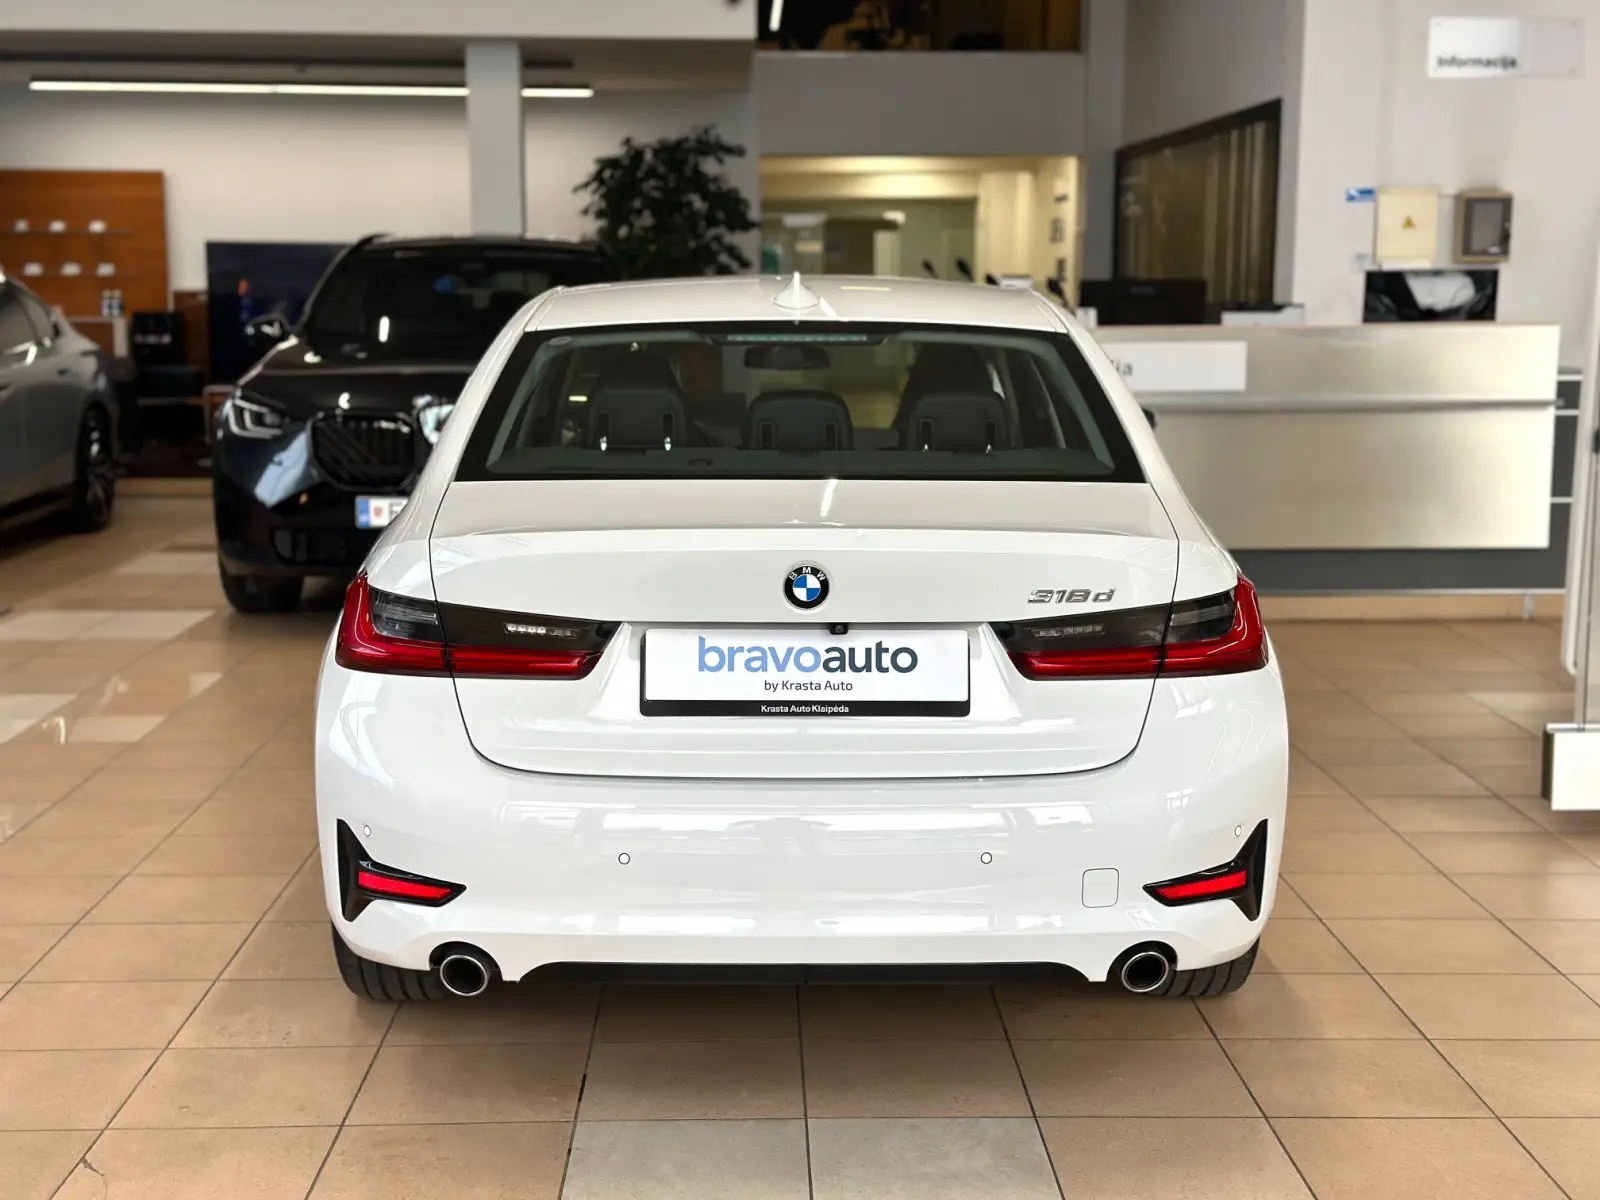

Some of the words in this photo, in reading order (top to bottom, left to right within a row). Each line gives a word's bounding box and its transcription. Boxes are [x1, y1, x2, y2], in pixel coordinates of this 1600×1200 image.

[788, 566, 826, 581] BMW
[1027, 587, 1117, 604] 318d
[698, 635, 919, 674] bravoauto
[764, 680, 779, 693] by
[781, 680, 821, 691] Krasta
[824, 680, 853, 691] Auto
[761, 704, 789, 713] Krasta
[789, 704, 811, 713] Auto
[811, 704, 849, 714] Klaipėda
